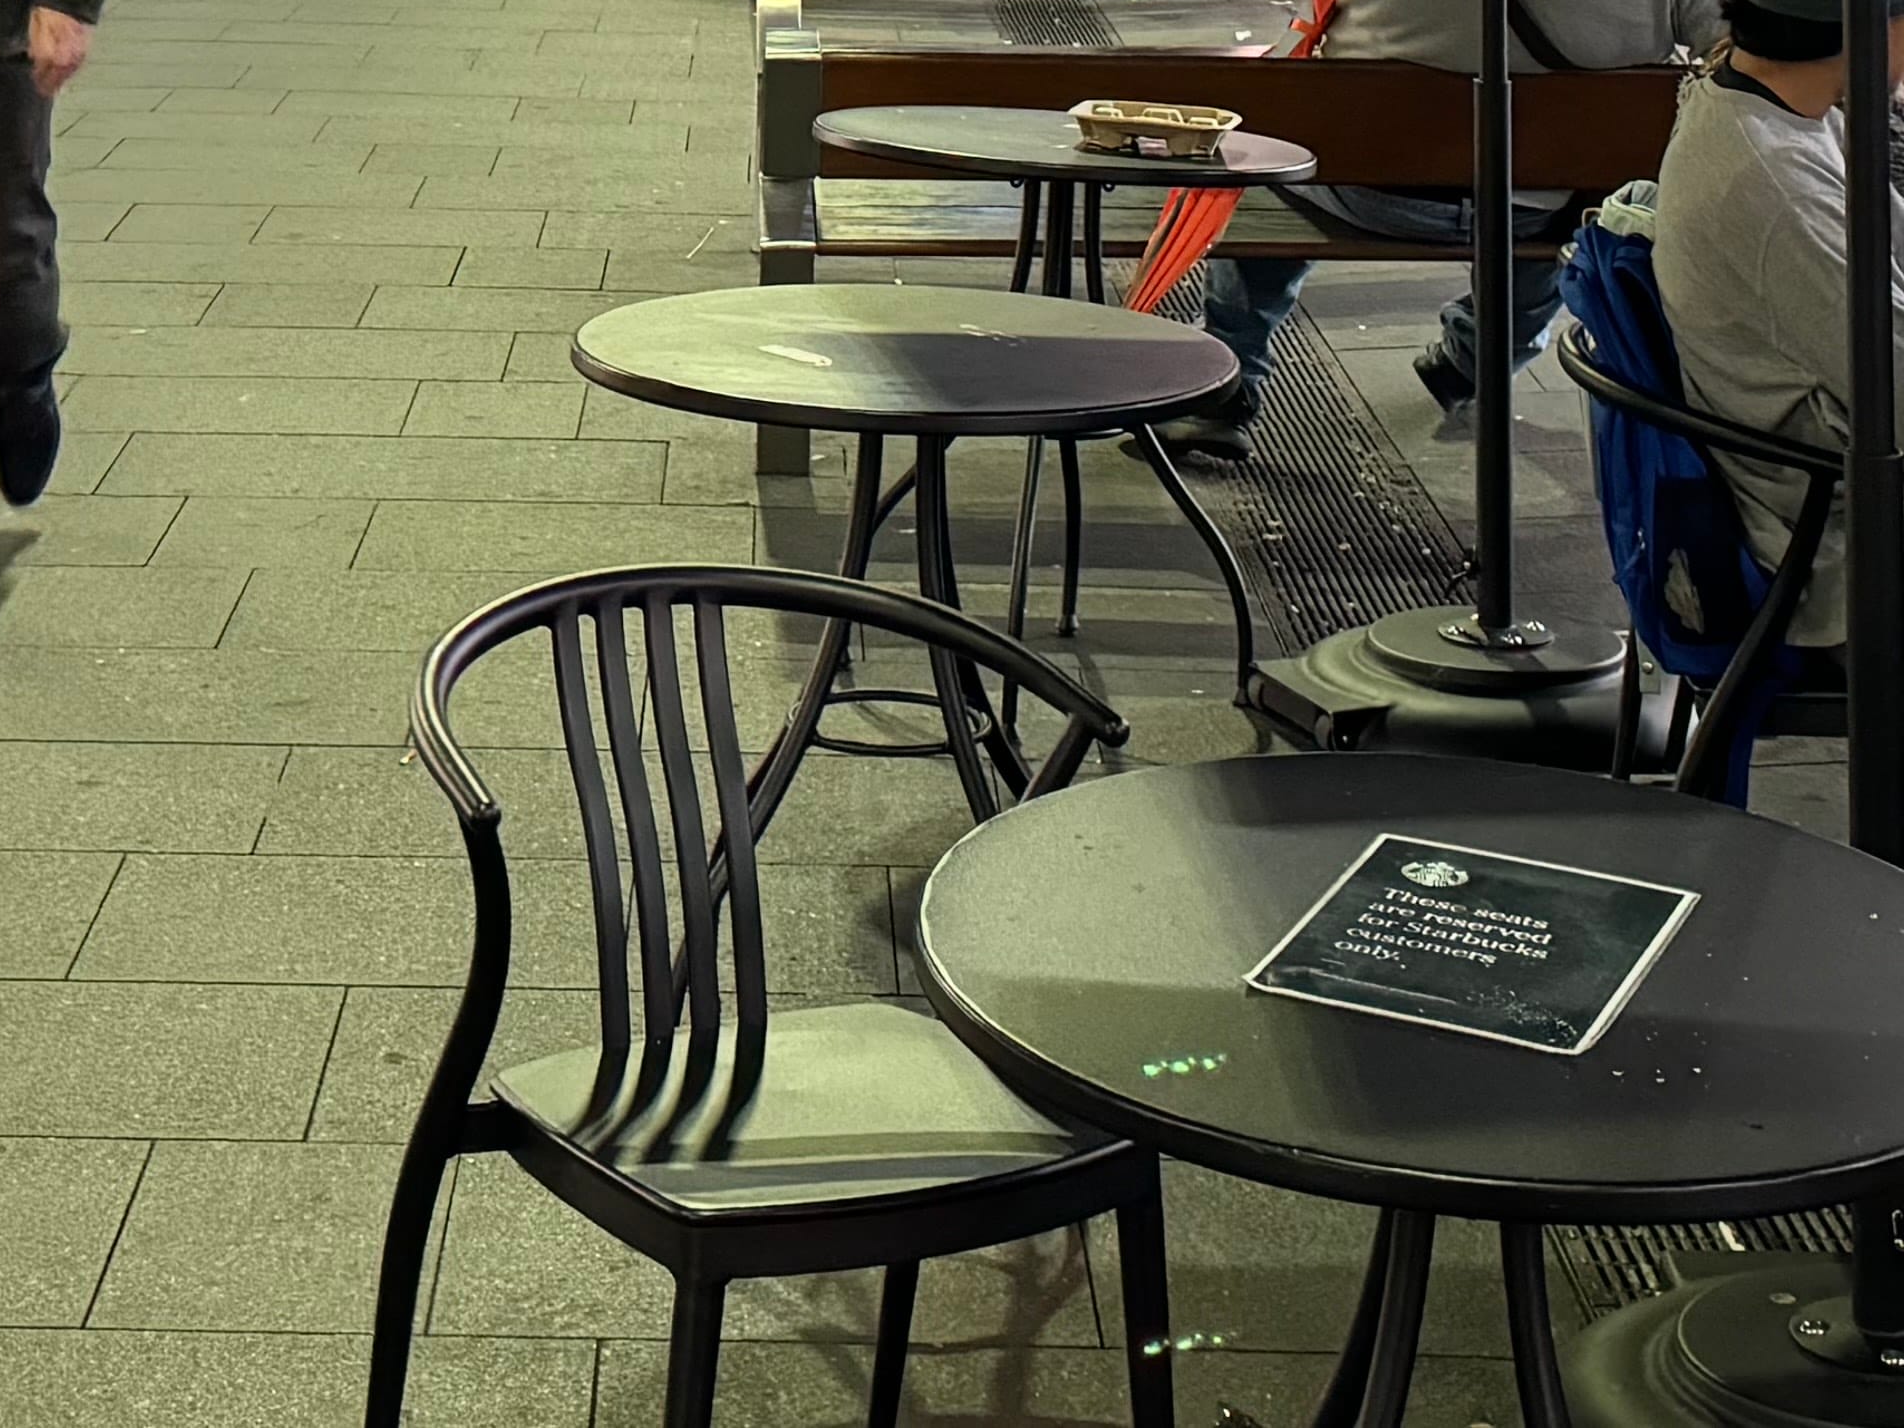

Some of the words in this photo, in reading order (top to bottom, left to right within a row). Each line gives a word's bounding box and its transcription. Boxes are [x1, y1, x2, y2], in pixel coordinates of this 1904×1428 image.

[1368, 902, 1416, 918] are
[1423, 913, 1552, 946] reserved
[1384, 887, 1468, 913] These
[1474, 907, 1549, 931] seats
[1334, 942, 1402, 962] only.
[1345, 928, 1498, 968] customers
[1358, 912, 1399, 929] for
[1402, 920, 1549, 961] Starbucks
